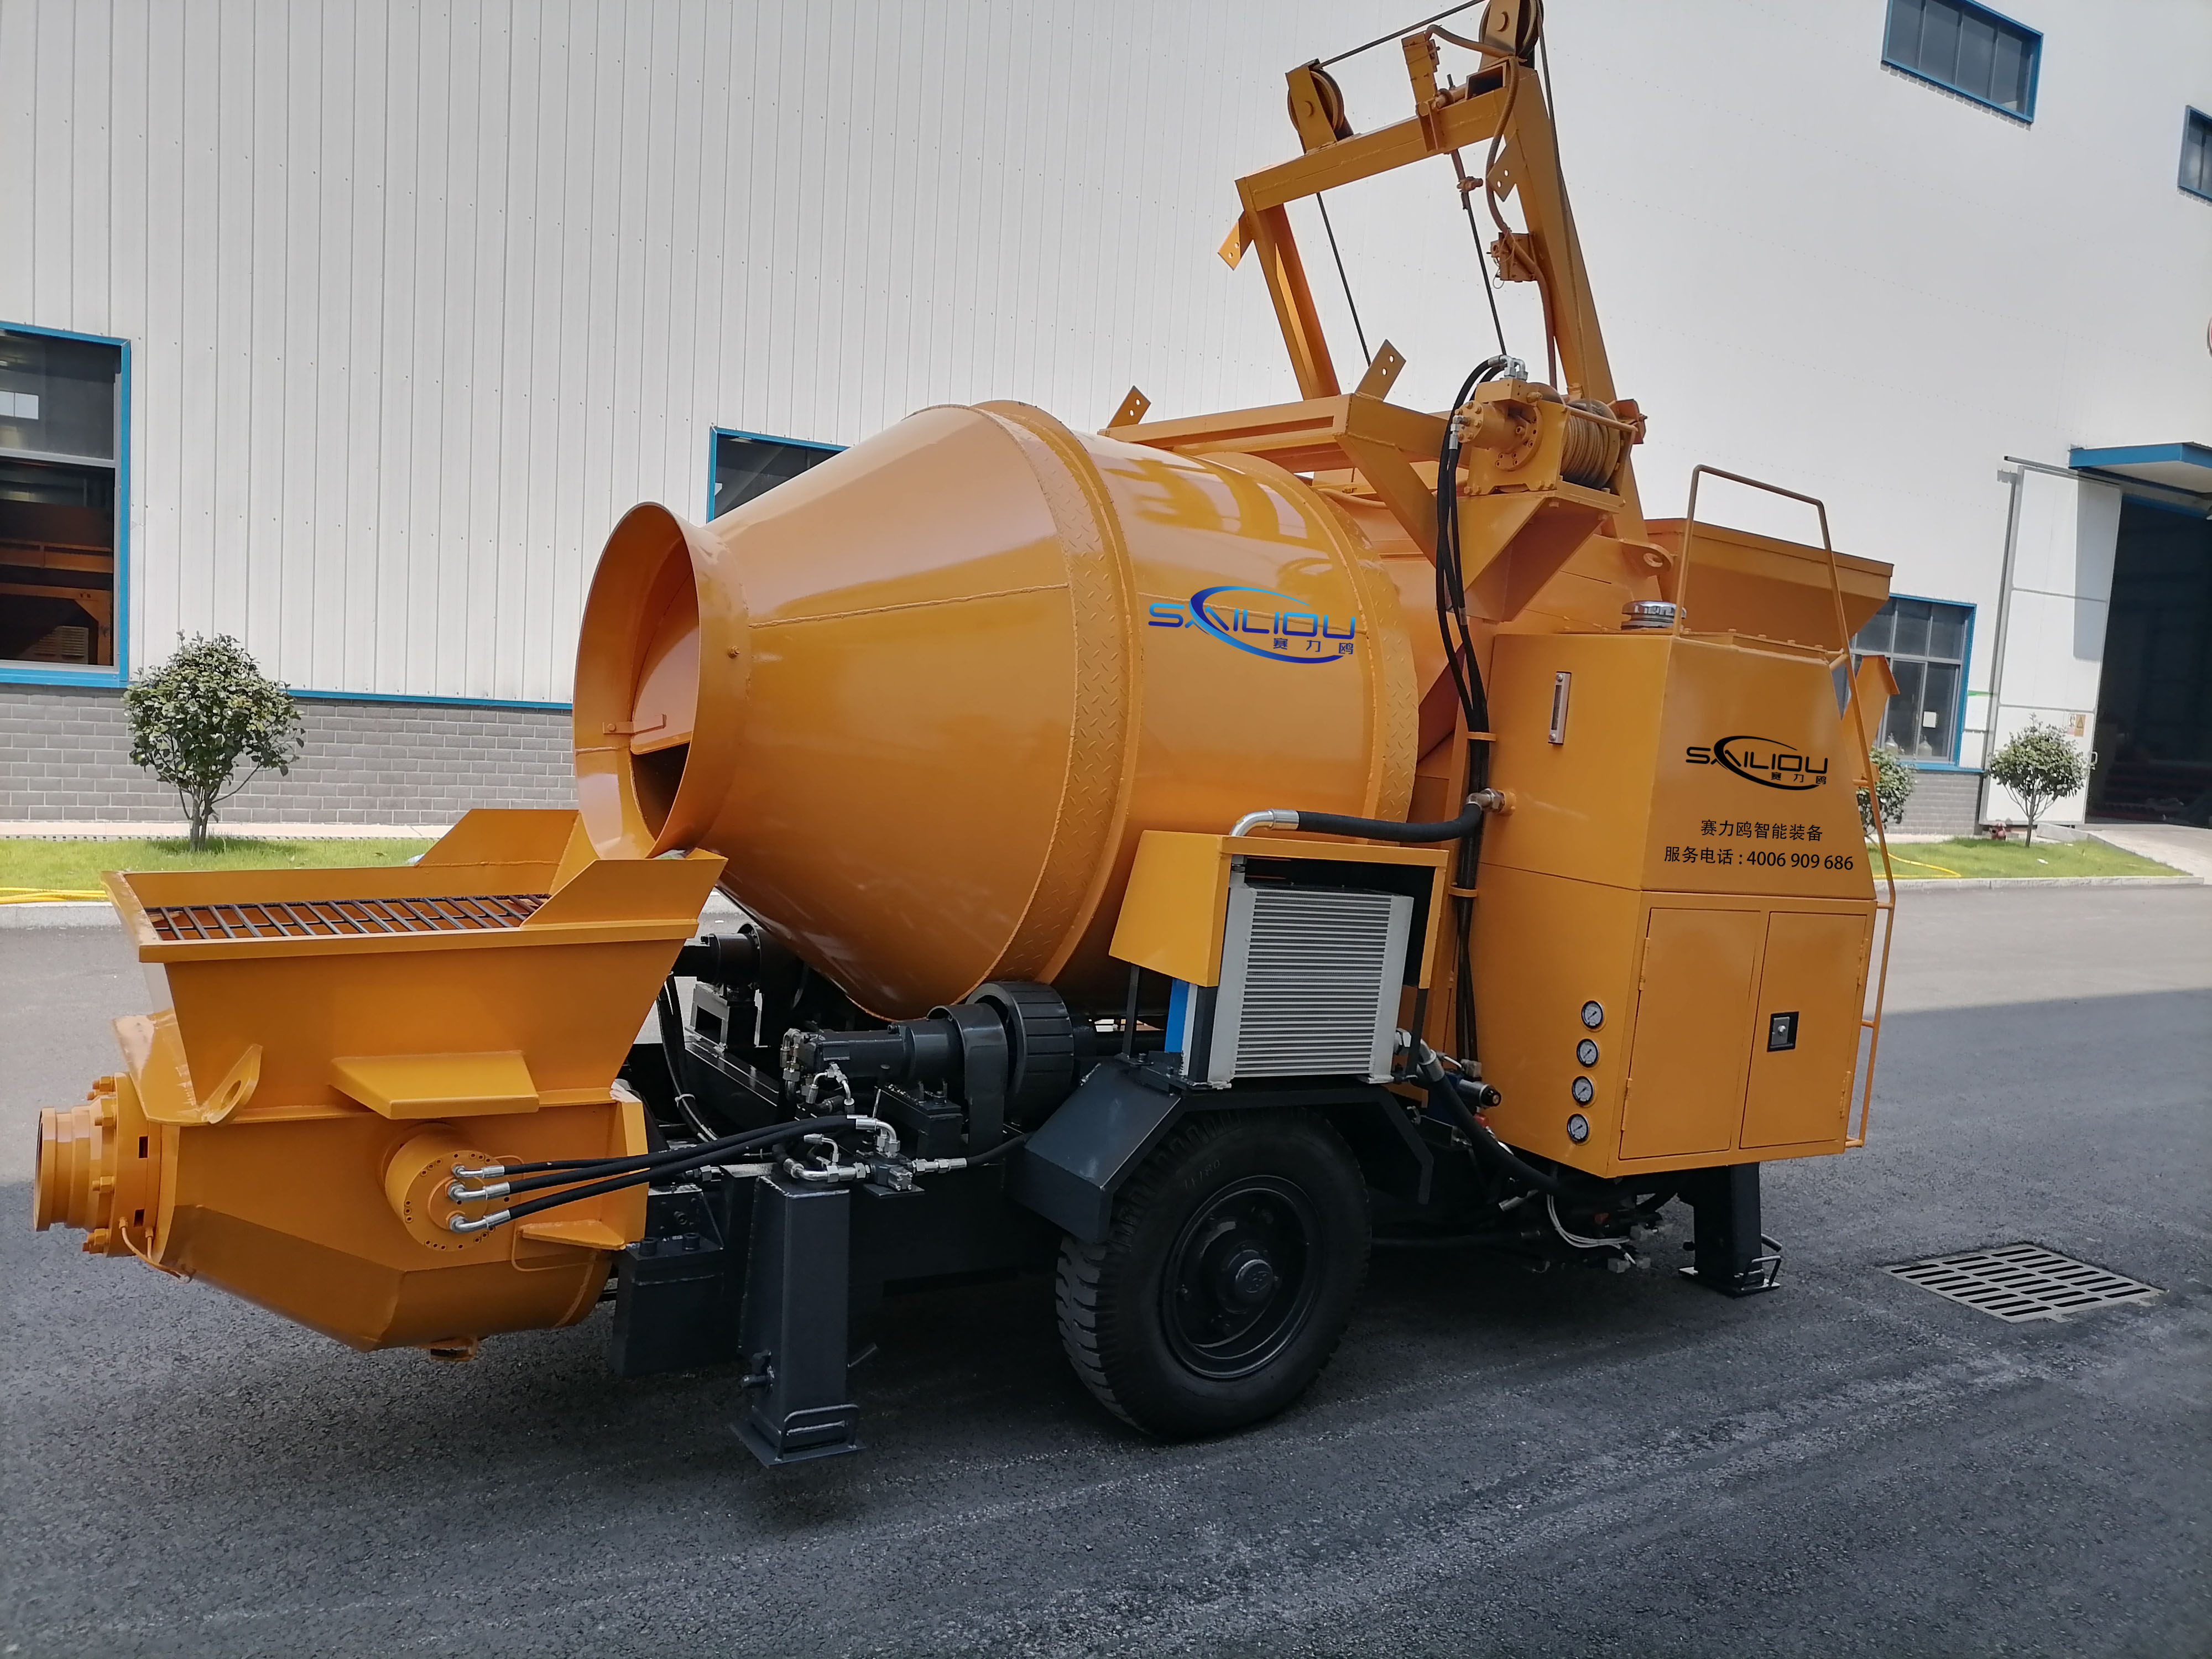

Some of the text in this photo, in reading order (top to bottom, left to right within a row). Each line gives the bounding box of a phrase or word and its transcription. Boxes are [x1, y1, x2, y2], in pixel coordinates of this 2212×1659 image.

[1273, 638, 1354, 655] 赛力鸥
[1771, 772, 1827, 785] 赛力鸥
[1700, 820, 1823, 841] 赛力鸥智能装备
[1791, 853, 1820, 868] 909
[1824, 855, 1854, 870] 686
